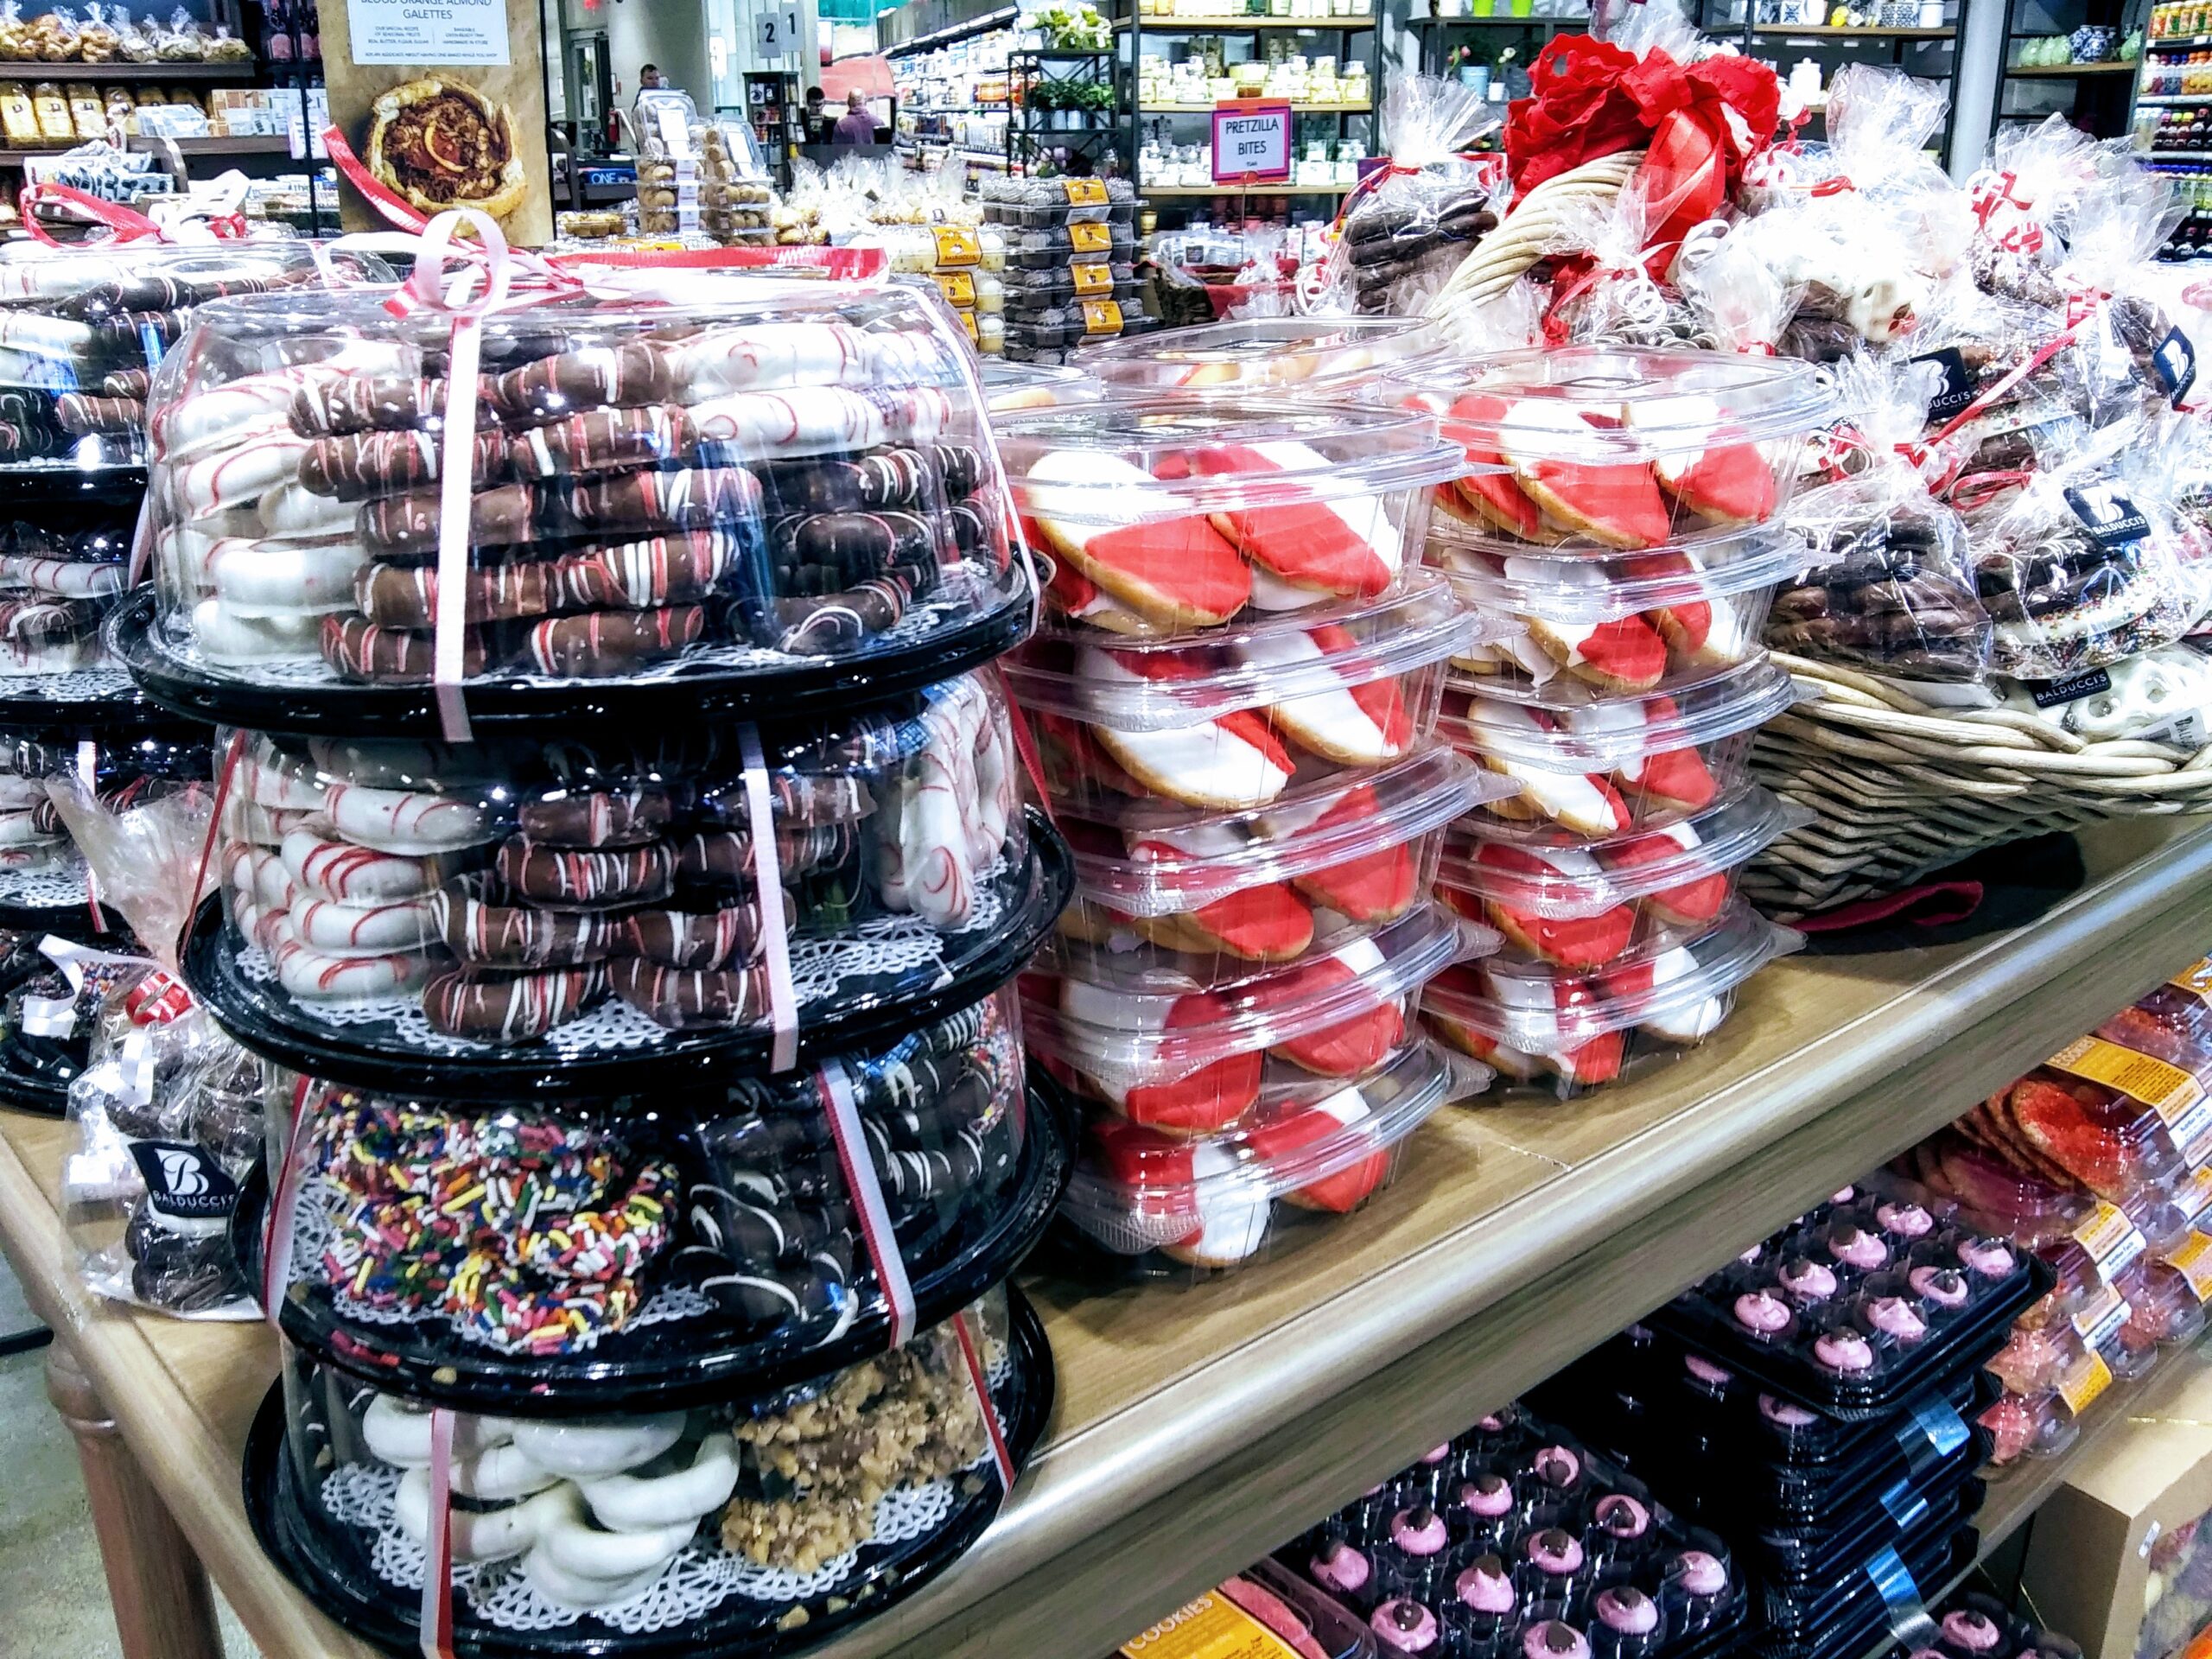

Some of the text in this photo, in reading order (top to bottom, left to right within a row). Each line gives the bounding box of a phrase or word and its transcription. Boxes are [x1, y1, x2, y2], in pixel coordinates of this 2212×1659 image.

[403, 10, 453, 19] GALETTES
[788, 12, 795, 35] 1
[765, 22, 775, 42] 2
[1225, 118, 1279, 134] PRETZILLA
[1238, 141, 1267, 155] BITES
[591, 172, 616, 184] ONE
[1927, 391, 1970, 410] DUCCI'S
[2092, 516, 2145, 535] BALDUCCI'S
[2036, 674, 2107, 701] BALDUCCI'S
[1128, 1595, 1214, 1650] COOKIES
